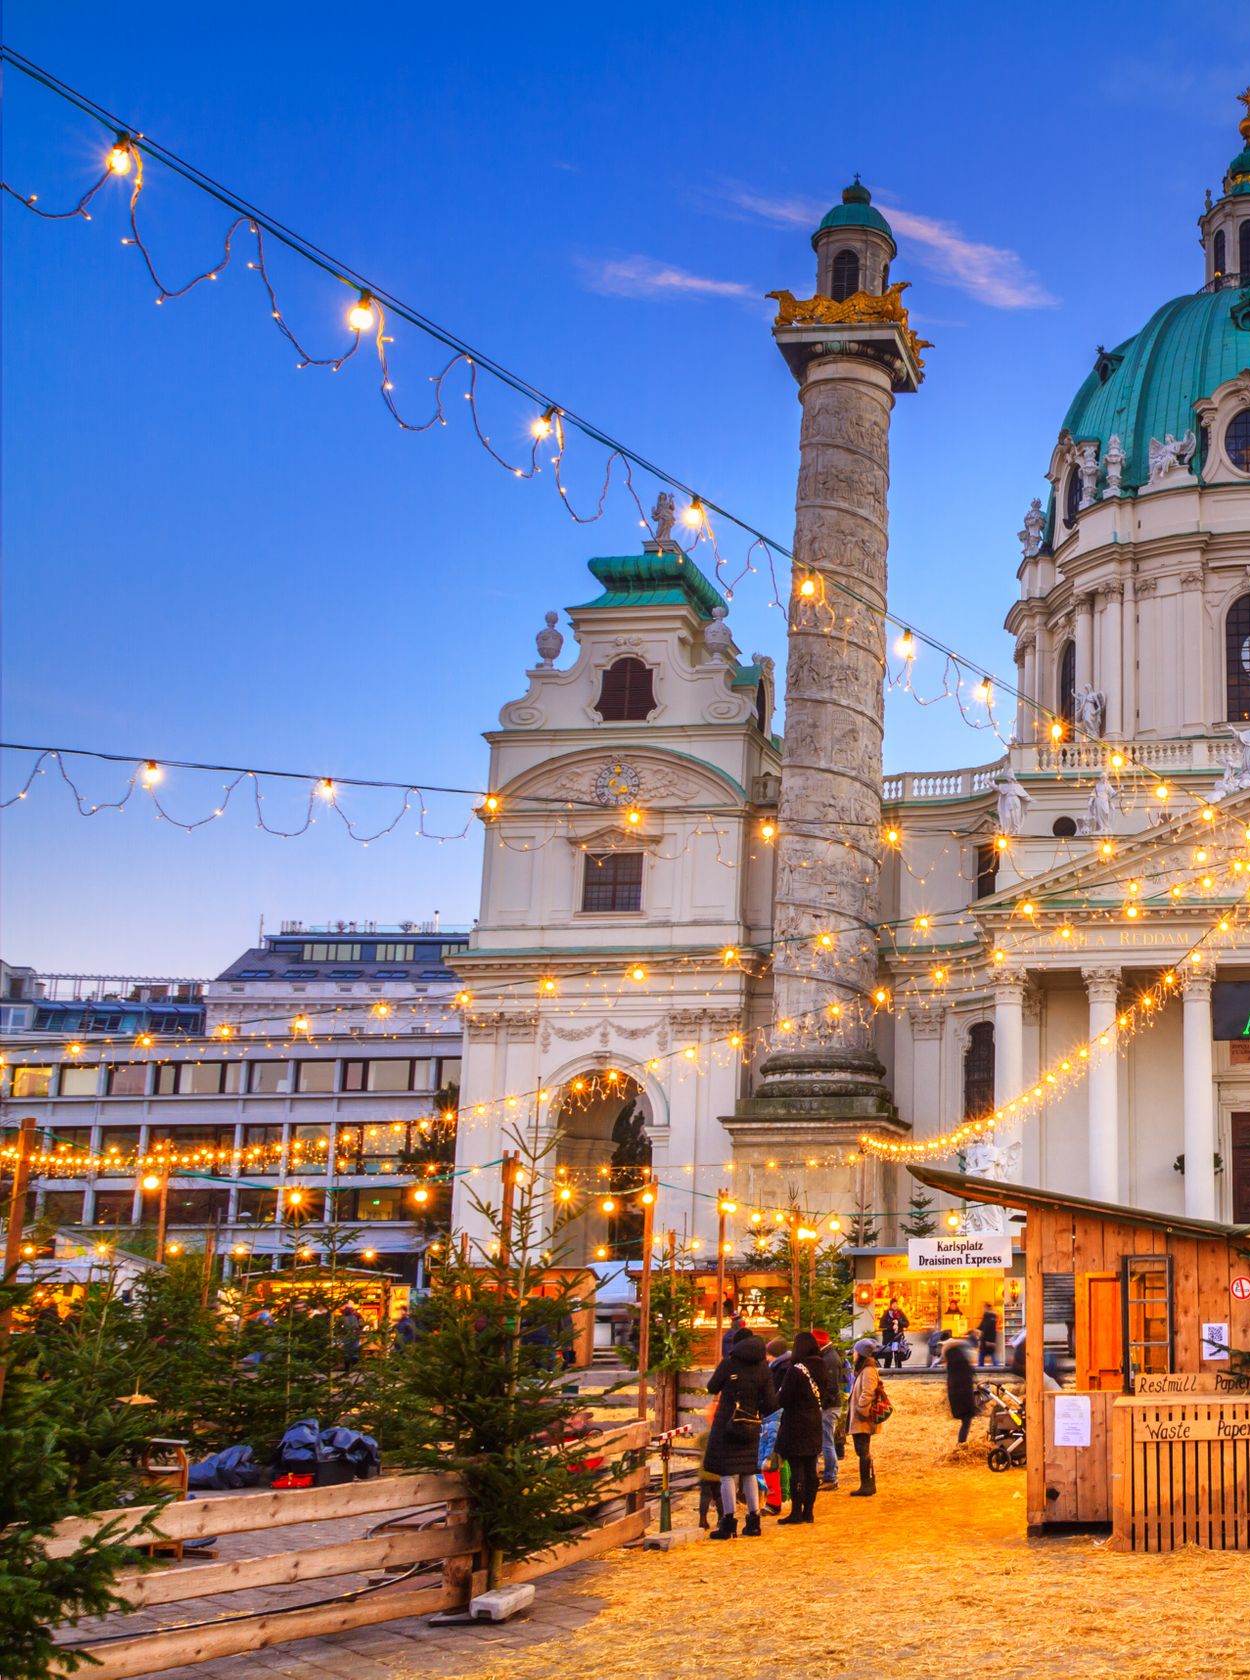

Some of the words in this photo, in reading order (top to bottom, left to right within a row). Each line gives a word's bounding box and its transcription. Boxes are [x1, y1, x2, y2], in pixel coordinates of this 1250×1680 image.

[1119, 931, 1189, 945] REDDAM
[937, 1241, 983, 1255] Karlsplatz
[919, 1255, 963, 1267] Draisinen
[965, 1253, 1002, 1267] Express
[1138, 1375, 1197, 1393] Restmüll
[1145, 1421, 1191, 1440] Waste
